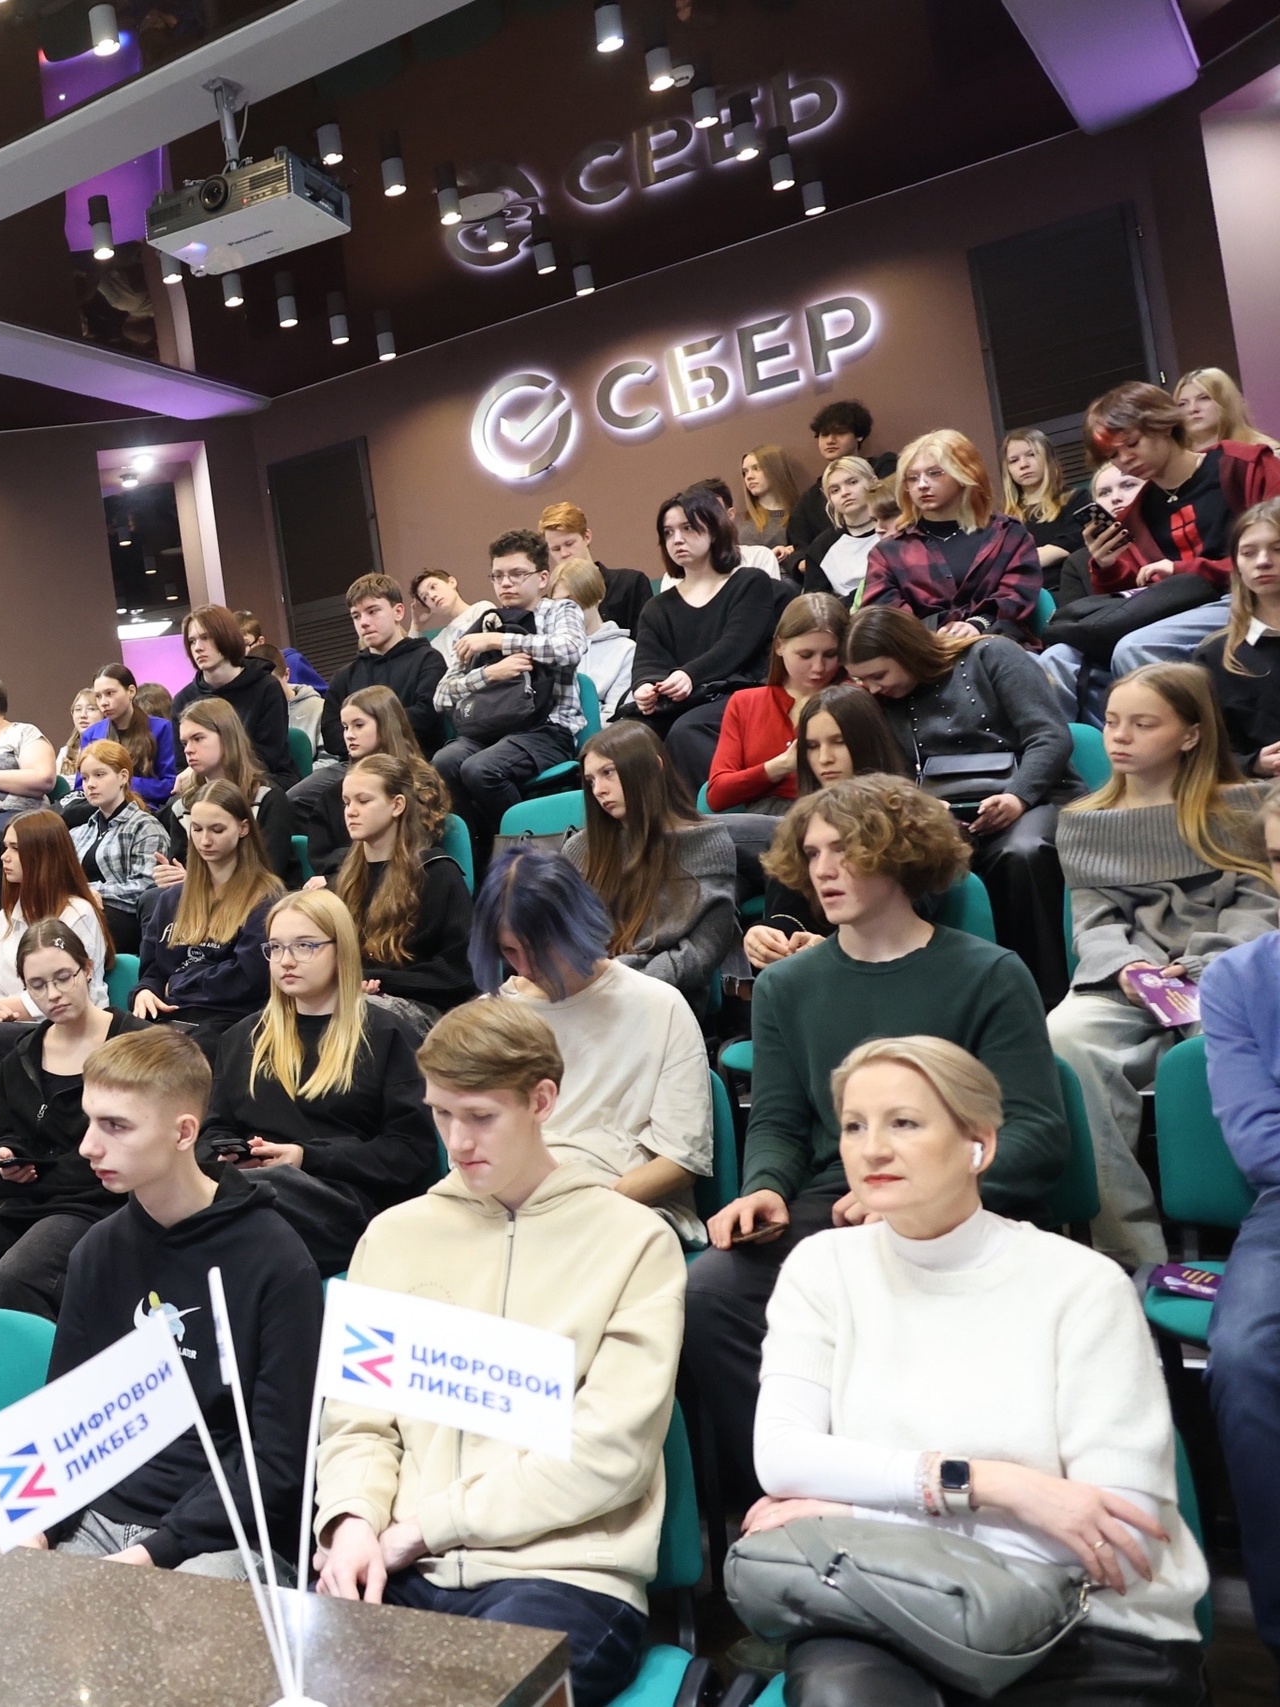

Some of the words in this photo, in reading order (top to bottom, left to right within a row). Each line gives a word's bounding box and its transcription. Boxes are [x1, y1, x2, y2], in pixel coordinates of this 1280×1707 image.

[596, 296, 872, 430] СБЕР
[408, 1372, 511, 1413] ЛИКБЕЗ
[411, 1344, 561, 1399] ЦИФРОВОЙ
[53, 1360, 172, 1453] ЦИФРОВОЙ
[65, 1413, 148, 1481] ЛИКБЕЗ
